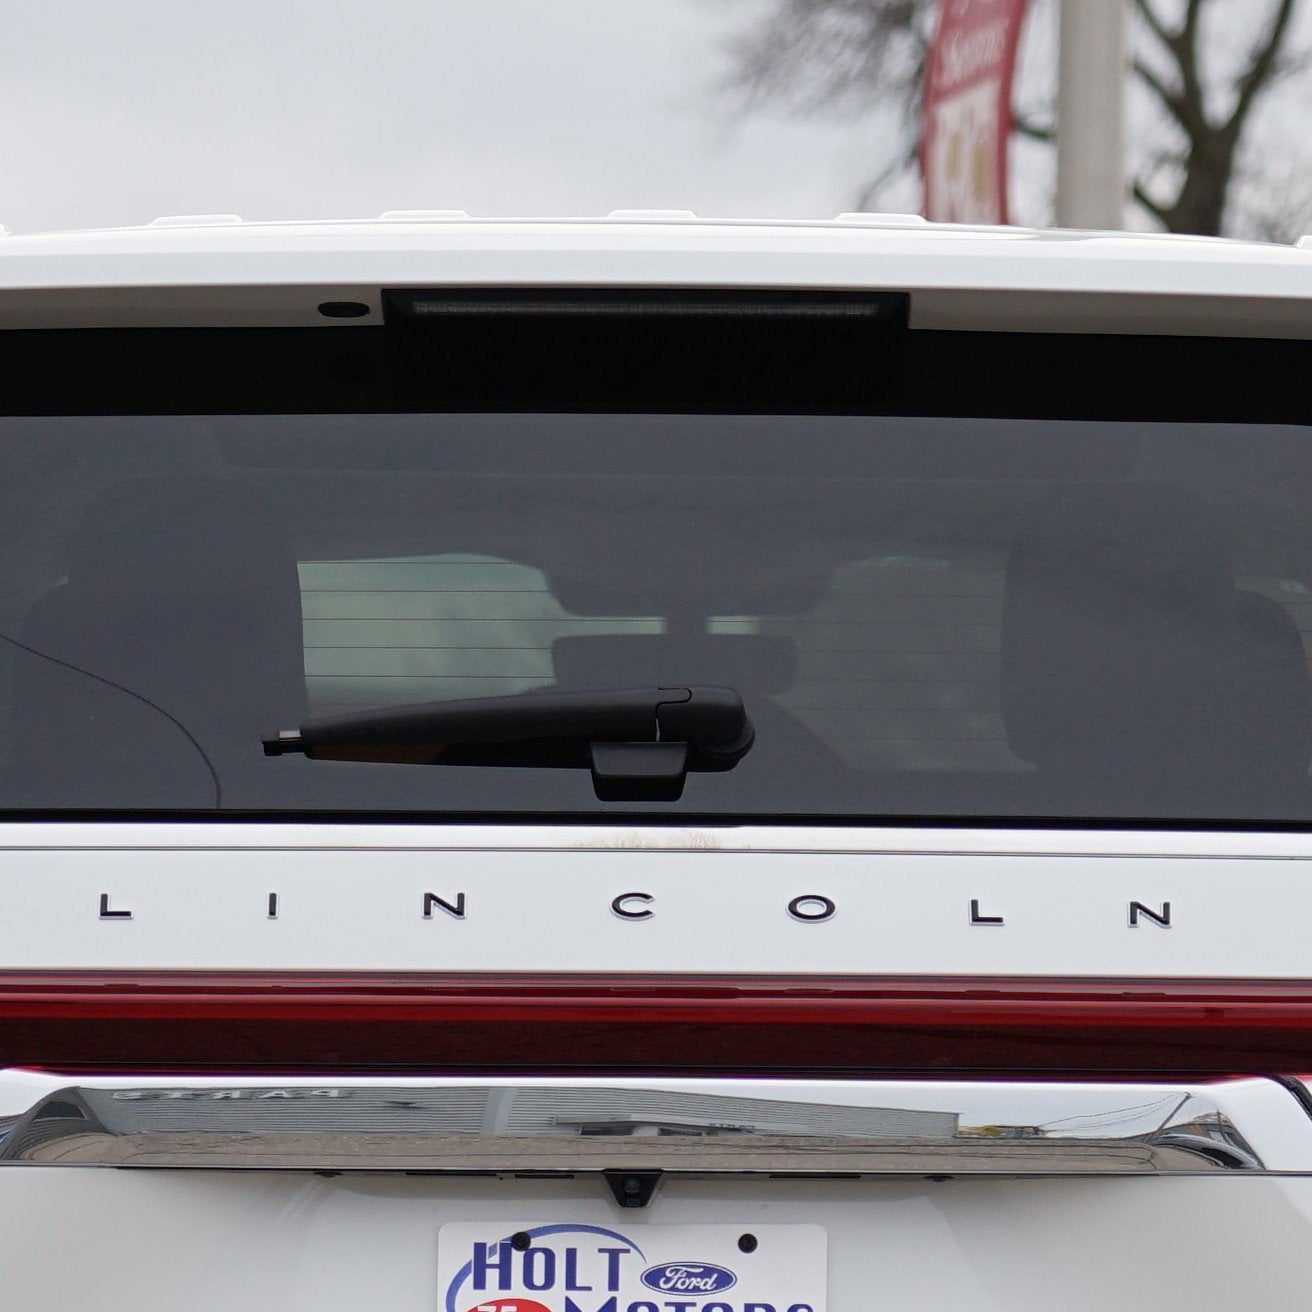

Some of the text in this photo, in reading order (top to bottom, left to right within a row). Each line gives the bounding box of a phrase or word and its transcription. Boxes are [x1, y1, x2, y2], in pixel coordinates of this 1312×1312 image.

[98, 891, 1172, 929] LINCOLN
[472, 1241, 631, 1292] HOLT
[659, 1265, 718, 1291] Ford
